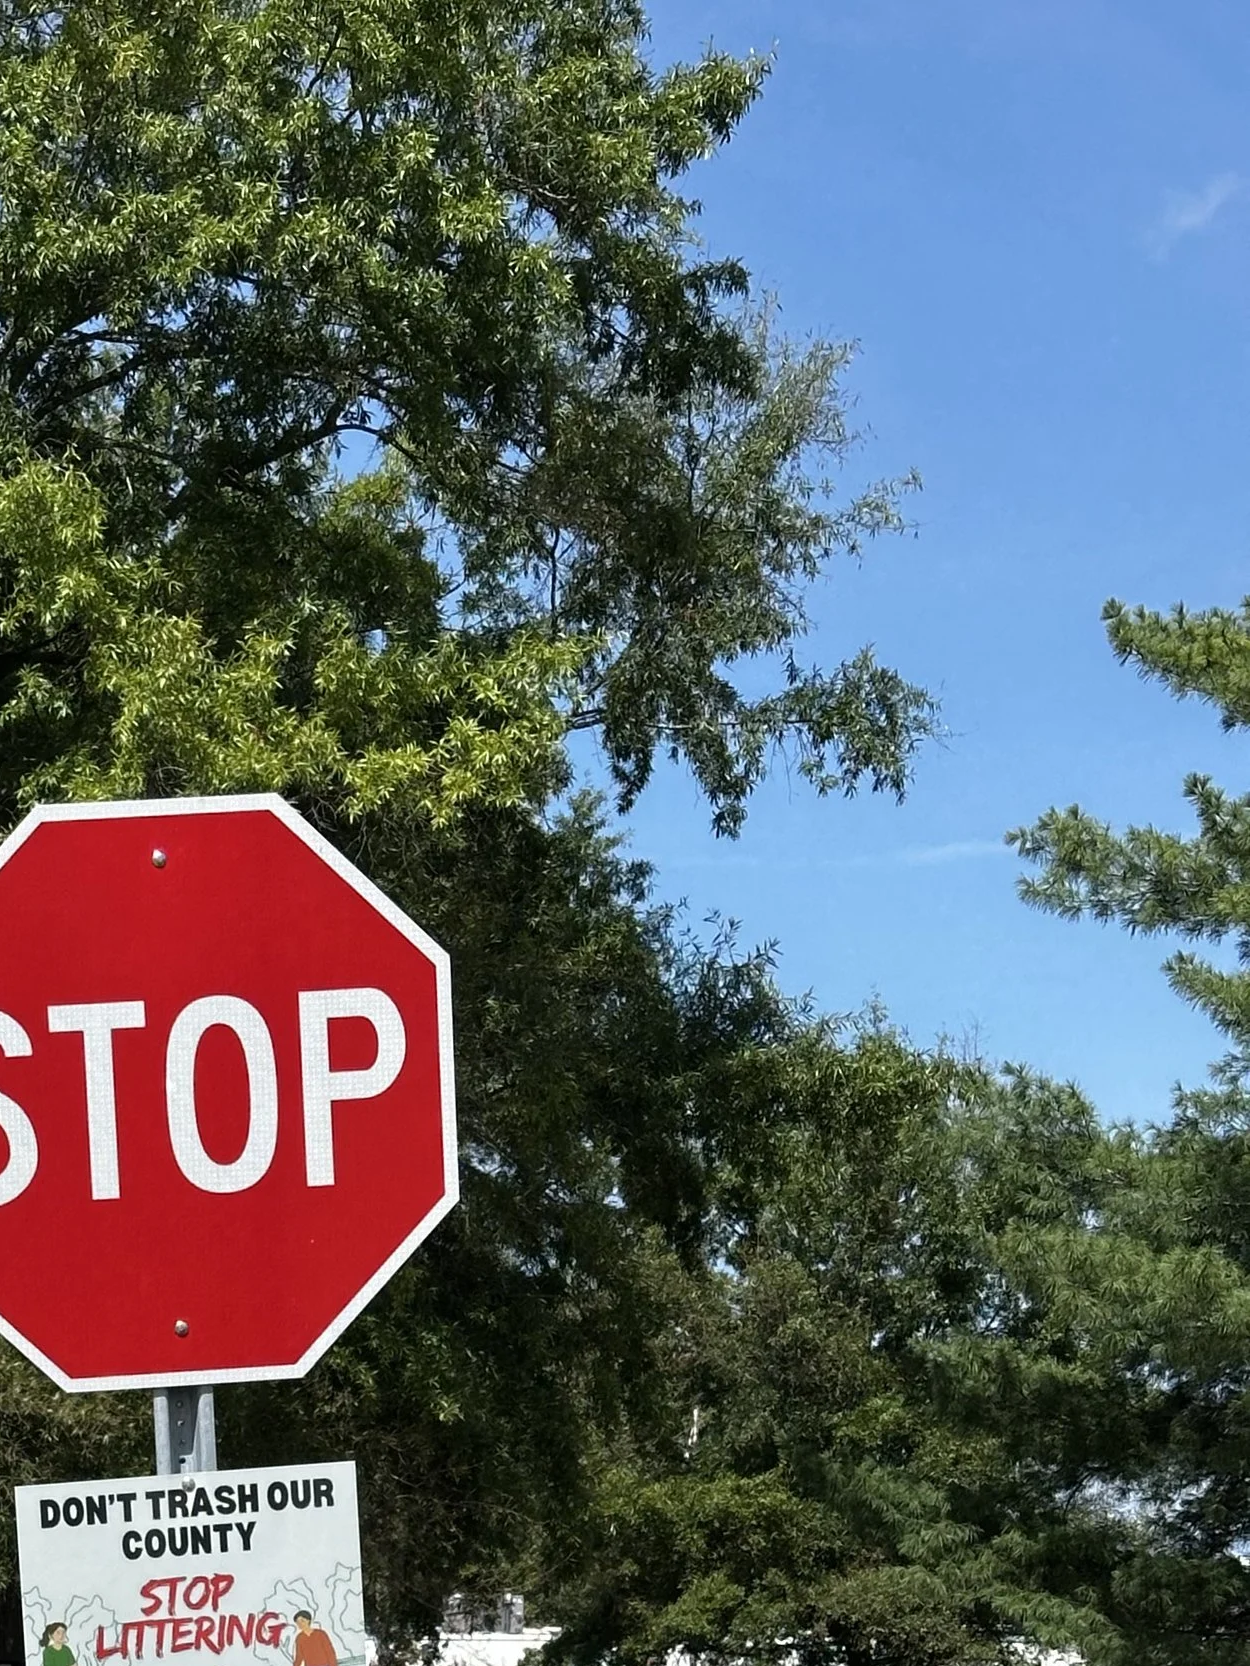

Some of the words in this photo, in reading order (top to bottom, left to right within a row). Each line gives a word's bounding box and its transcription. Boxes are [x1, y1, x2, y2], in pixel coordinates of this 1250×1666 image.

[40, 1492, 137, 1528] DON'T
[146, 1484, 259, 1520] TRASH
[267, 1478, 334, 1510] OUR
[122, 1521, 257, 1560] COUNTY
[140, 1573, 234, 1616] STOP
[95, 1612, 287, 1660] LITTERING
